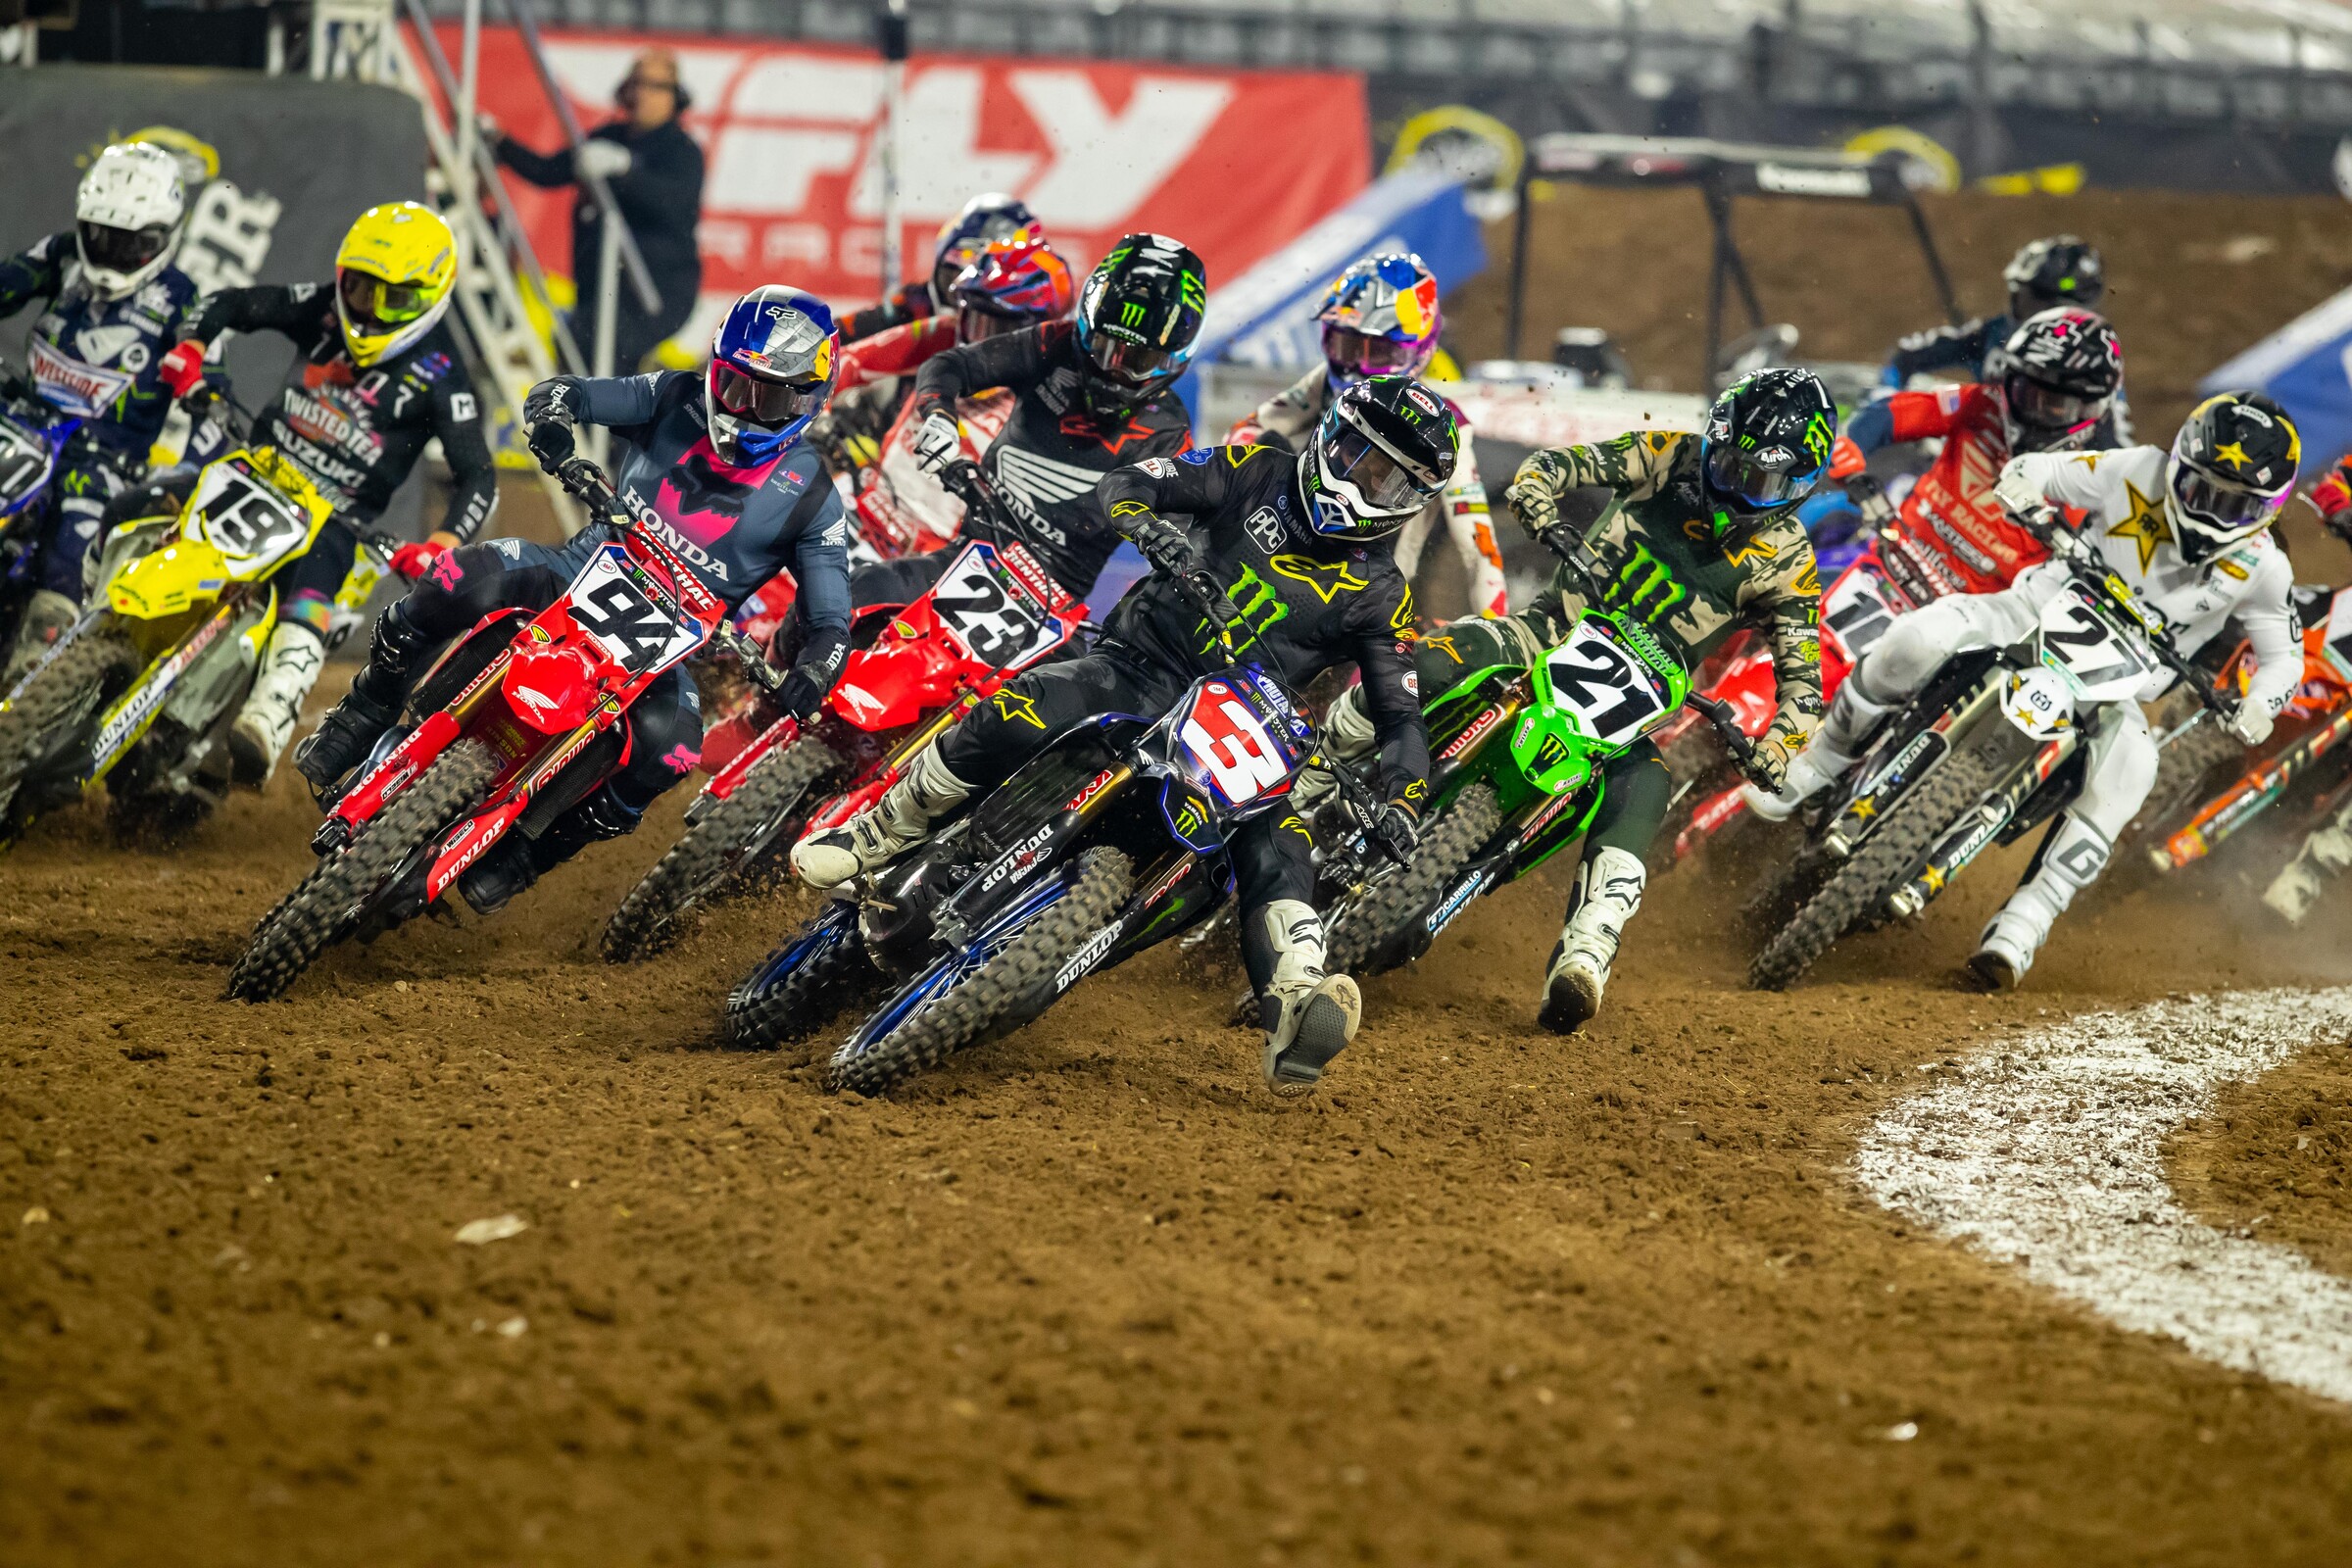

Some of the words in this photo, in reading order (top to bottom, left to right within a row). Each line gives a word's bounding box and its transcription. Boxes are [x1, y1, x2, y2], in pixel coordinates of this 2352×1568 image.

[283, 387, 349, 443] TWISTED
[345, 424, 383, 466] TEA
[1411, 391, 1435, 413] BELL
[271, 418, 368, 488] SUZUKI
[198, 479, 298, 557] 19
[622, 485, 729, 582] HONDA
[986, 470, 1067, 547] HONDA
[1250, 510, 1284, 550] PPG
[1282, 507, 1314, 548] YAMAHA
[566, 577, 682, 674] 94
[642, 574, 678, 612] MONSTER
[931, 574, 1040, 668] 23
[2043, 606, 2143, 689] 27
[91, 683, 155, 756] DUNLOP
[511, 690, 545, 724] HONDA
[1258, 699, 1291, 743] MONSTER
[1548, 640, 1659, 740] 21
[350, 728, 422, 798] DUNLOP
[1181, 700, 1288, 805] 3
[1875, 735, 1932, 798] DUNLP
[1183, 802, 1204, 827] YAMAHA
[1353, 802, 1374, 830] ARC
[1947, 806, 2008, 868] DUNLP
[437, 816, 506, 892] DUNLOP
[982, 823, 1054, 893] DUNLOP
[1443, 870, 1482, 911] CARRILLO
[1056, 922, 1124, 994] DUNLOP
